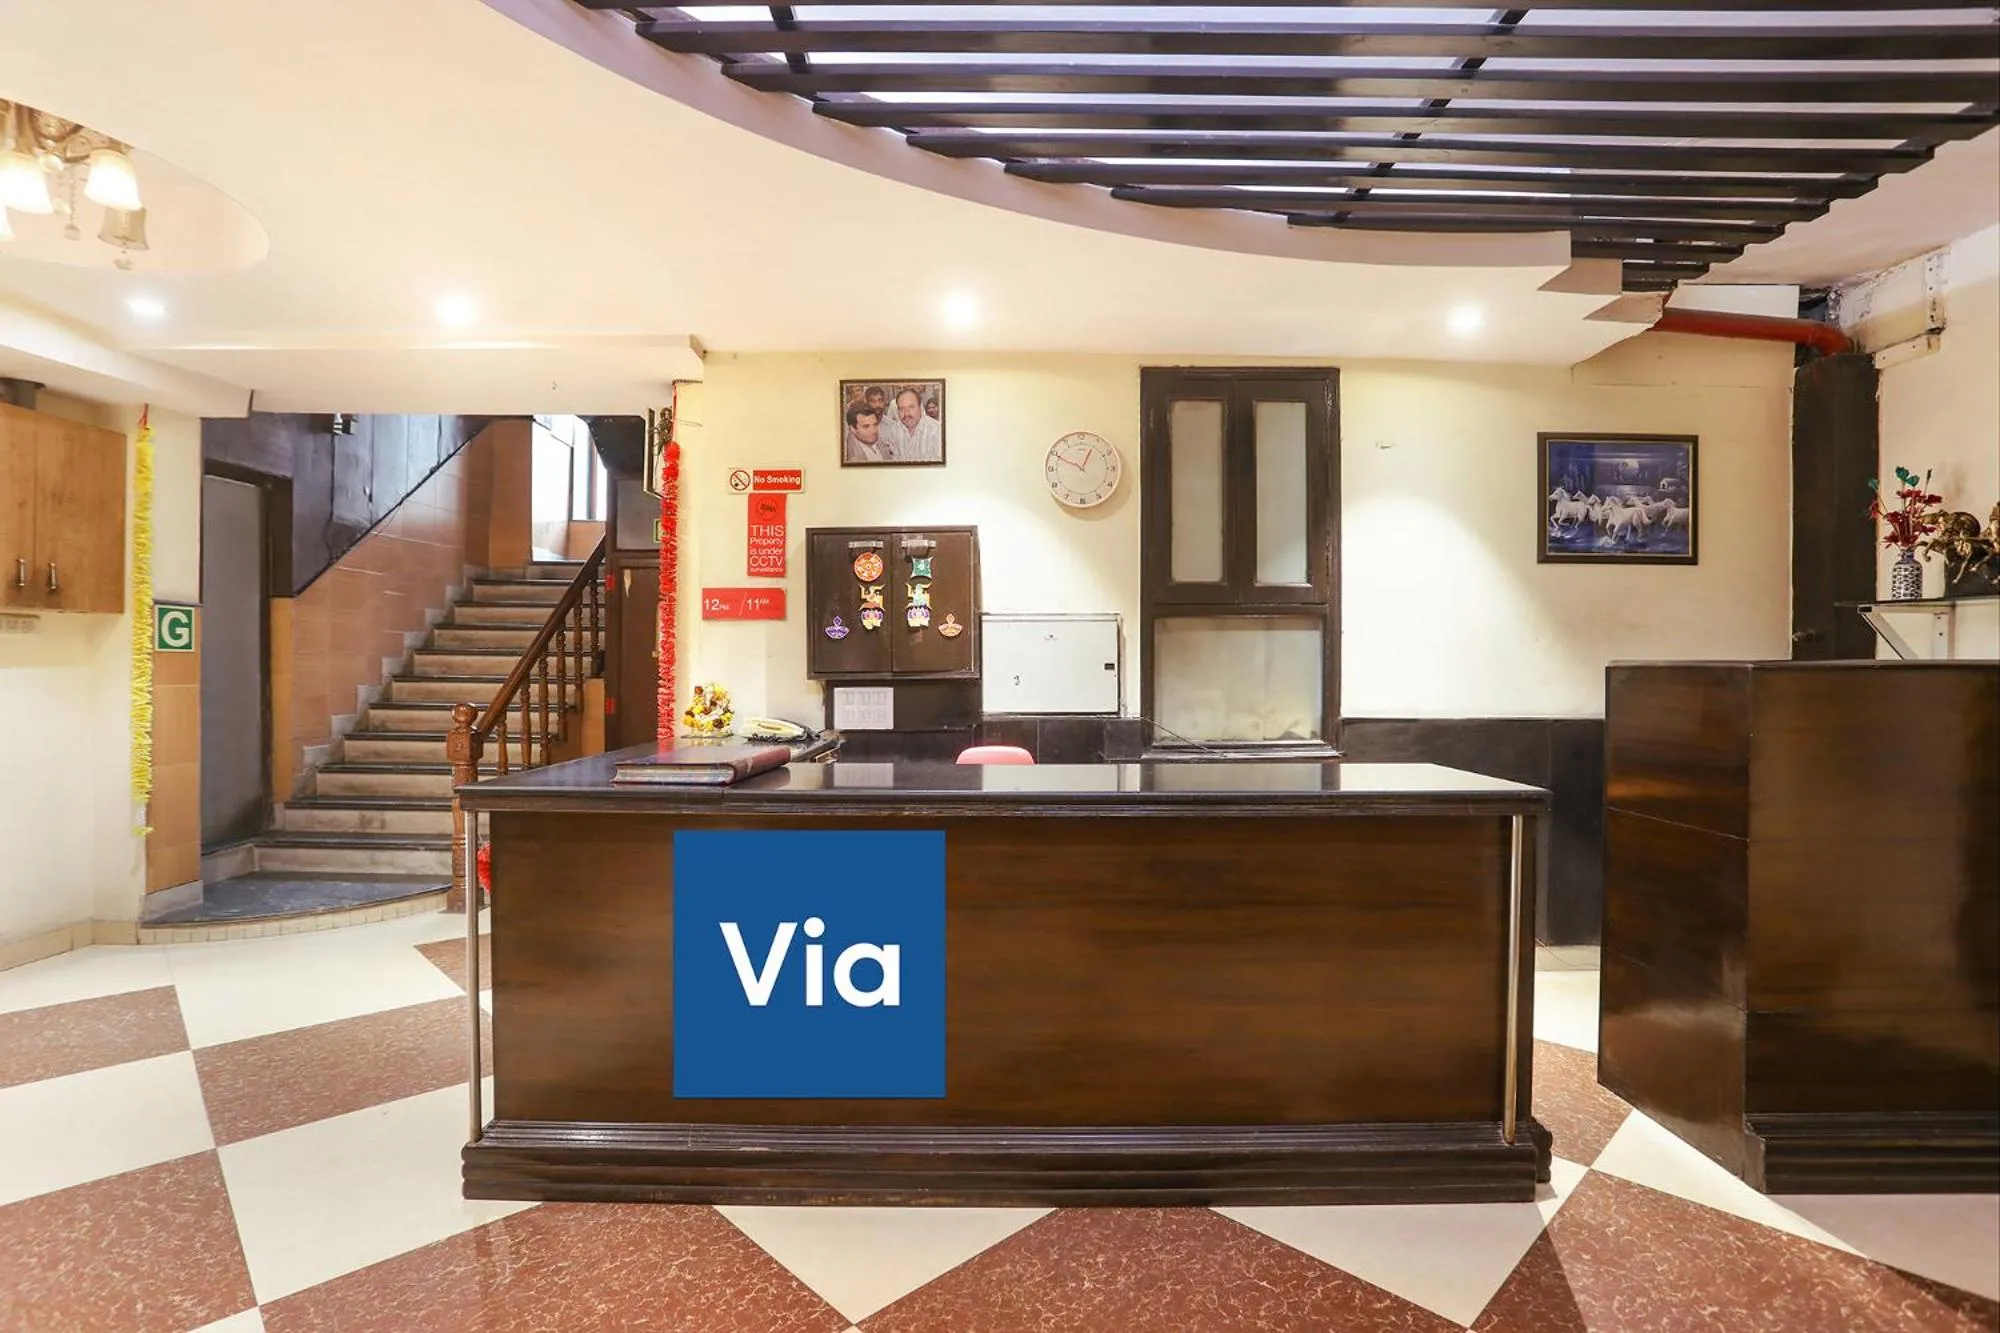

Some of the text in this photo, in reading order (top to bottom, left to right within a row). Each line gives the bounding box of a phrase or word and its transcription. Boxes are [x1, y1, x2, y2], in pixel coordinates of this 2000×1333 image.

[754, 475, 801, 486] No Smoking
[750, 524, 785, 537] THIS
[750, 555, 784, 567] CCTV
[161, 611, 190, 647] G
[719, 916, 900, 1008] Via
